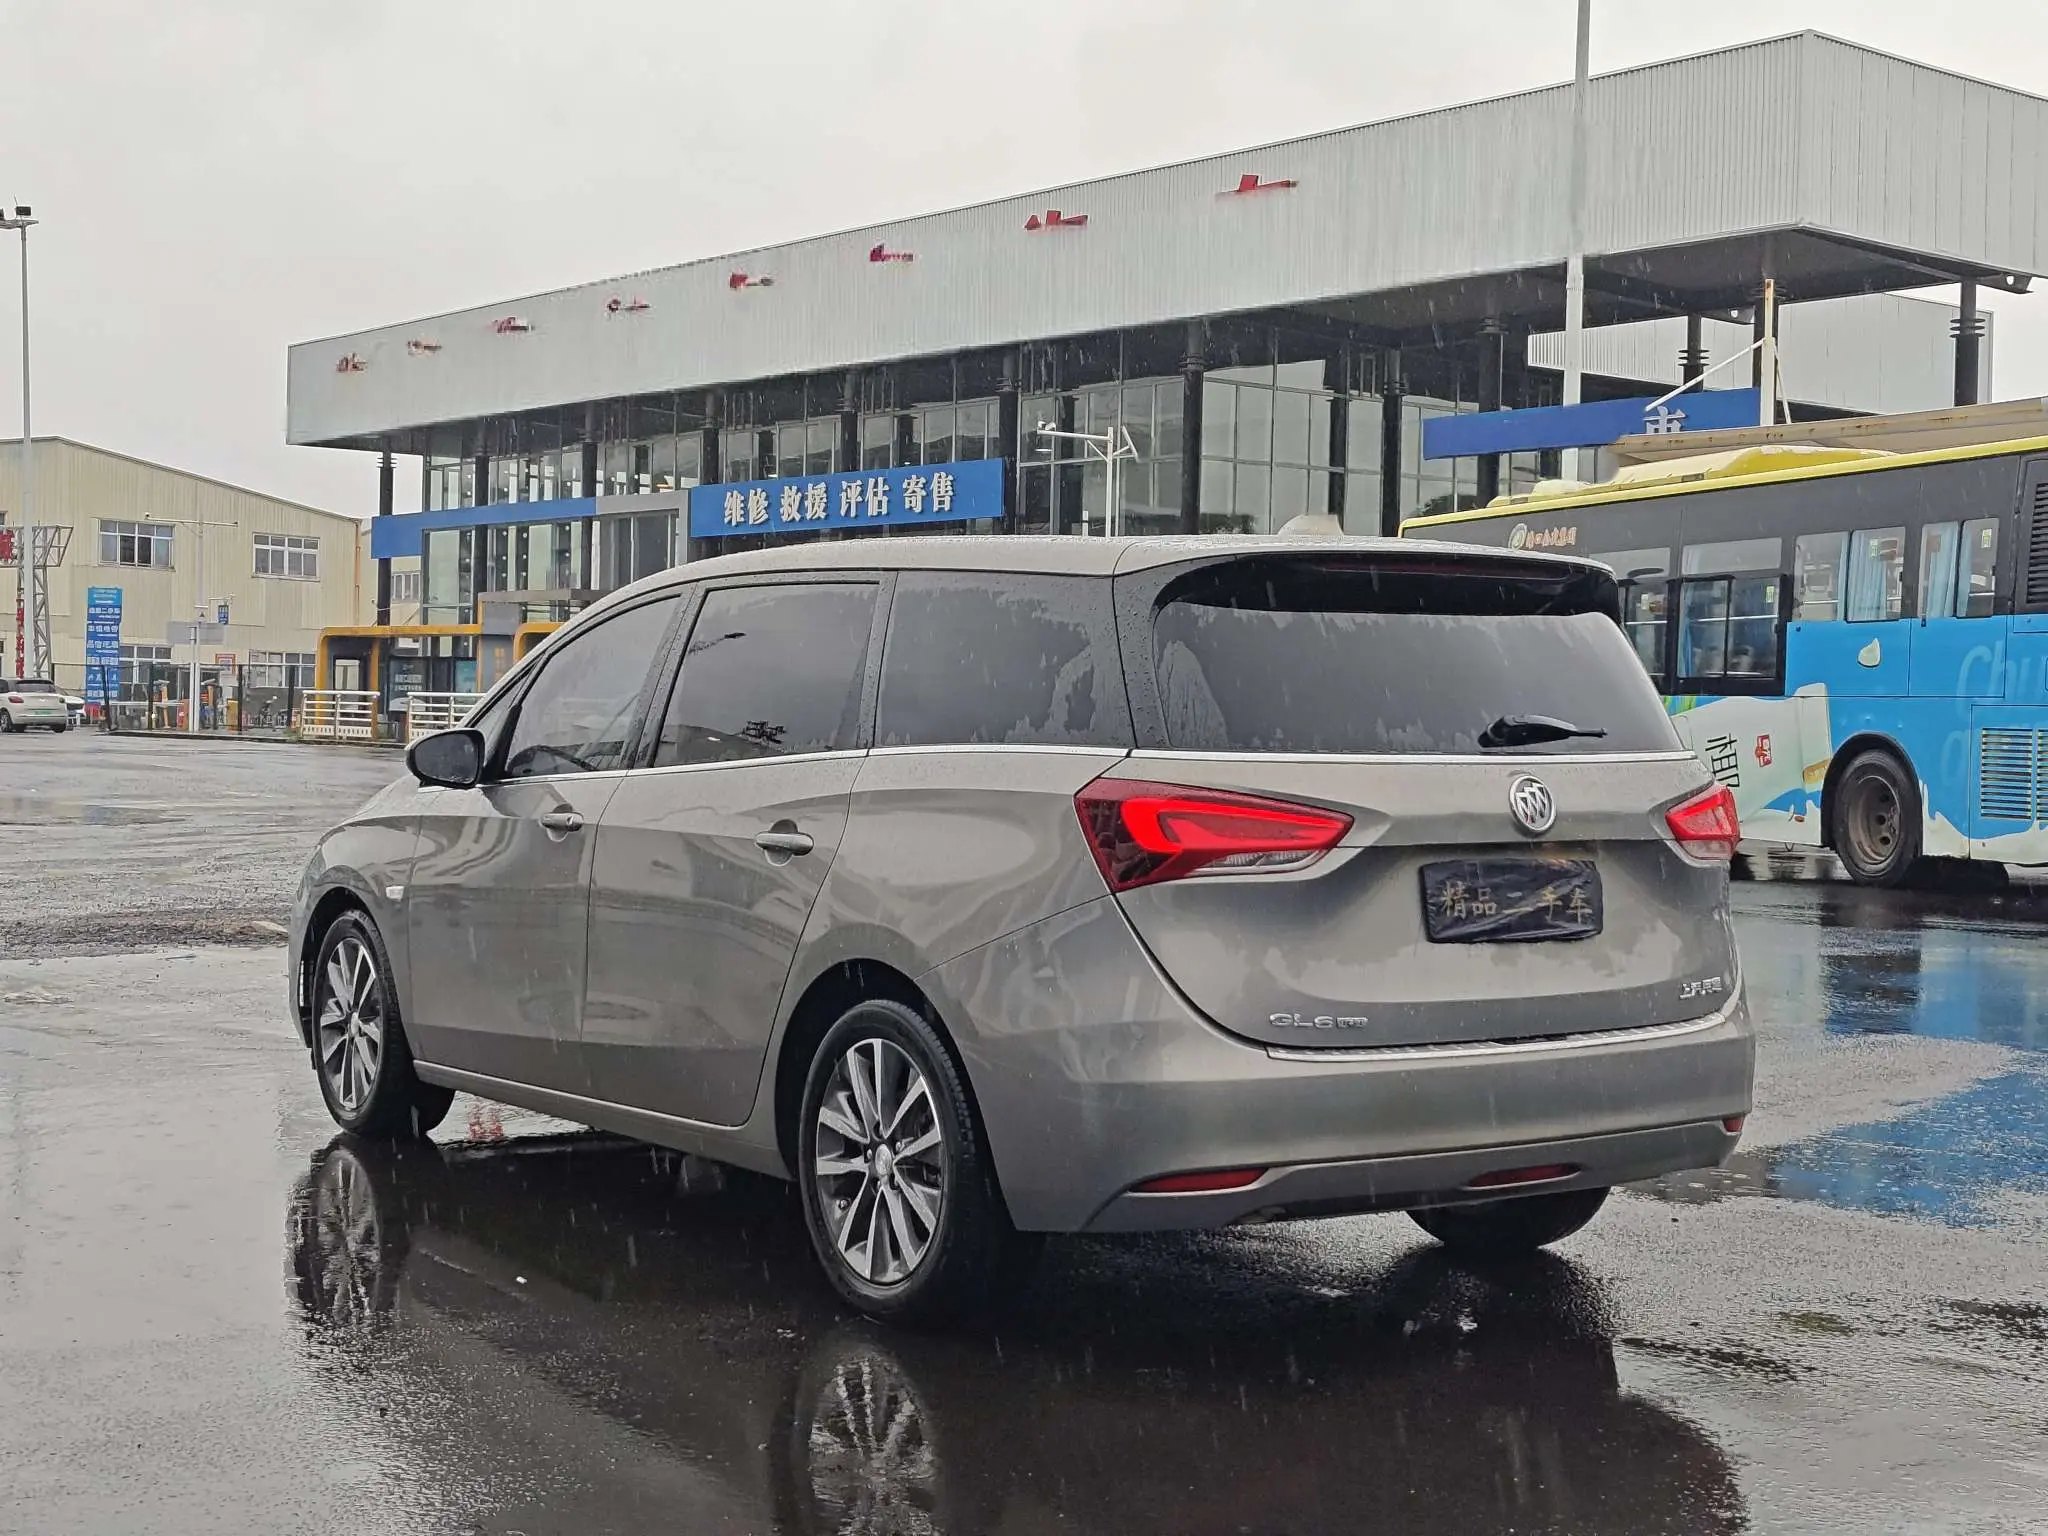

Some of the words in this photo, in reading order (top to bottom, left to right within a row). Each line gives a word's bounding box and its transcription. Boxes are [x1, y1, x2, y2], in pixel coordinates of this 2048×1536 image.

[724, 488, 769, 526] 维修
[780, 481, 828, 522] 救援
[839, 476, 890, 517] 评估
[902, 471, 955, 514] 寄售
[1440, 878, 1593, 924] 精品二手车
[1269, 1012, 1334, 1029] GL6
